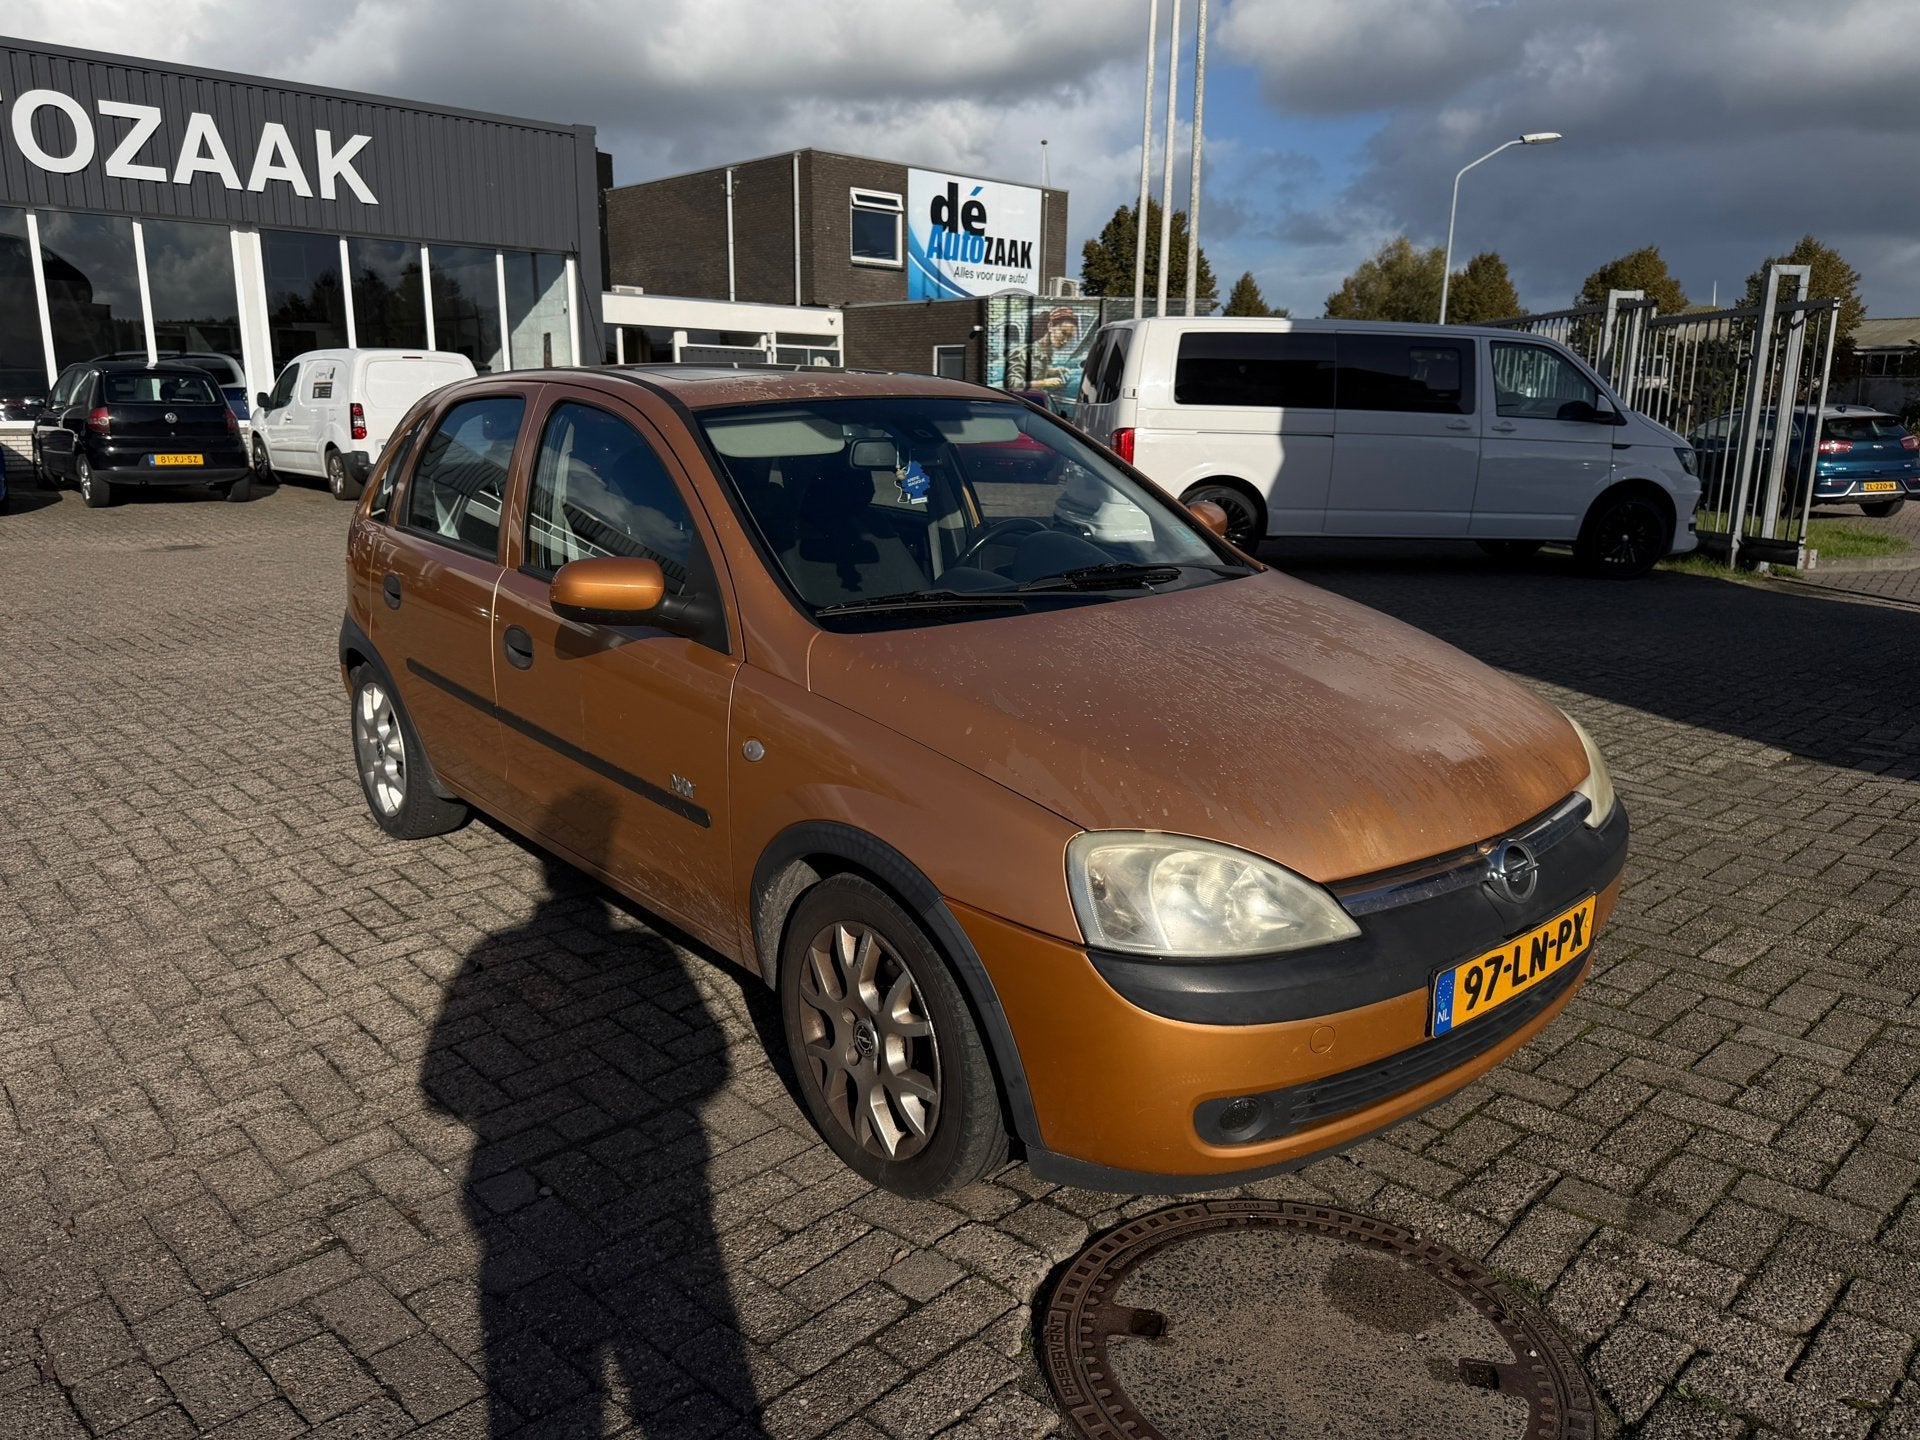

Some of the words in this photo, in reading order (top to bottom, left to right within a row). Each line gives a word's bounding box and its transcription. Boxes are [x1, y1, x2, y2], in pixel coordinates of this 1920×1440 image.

[0, 88, 380, 206] OZAAK
[929, 181, 988, 237] dé
[953, 266, 975, 280] Alles
[976, 270, 995, 281] voor
[995, 273, 1008, 282] uw
[1008, 274, 1029, 285] auto!
[1463, 907, 1588, 1011] 97-LN-PX
[1437, 1007, 1450, 1025] NL
